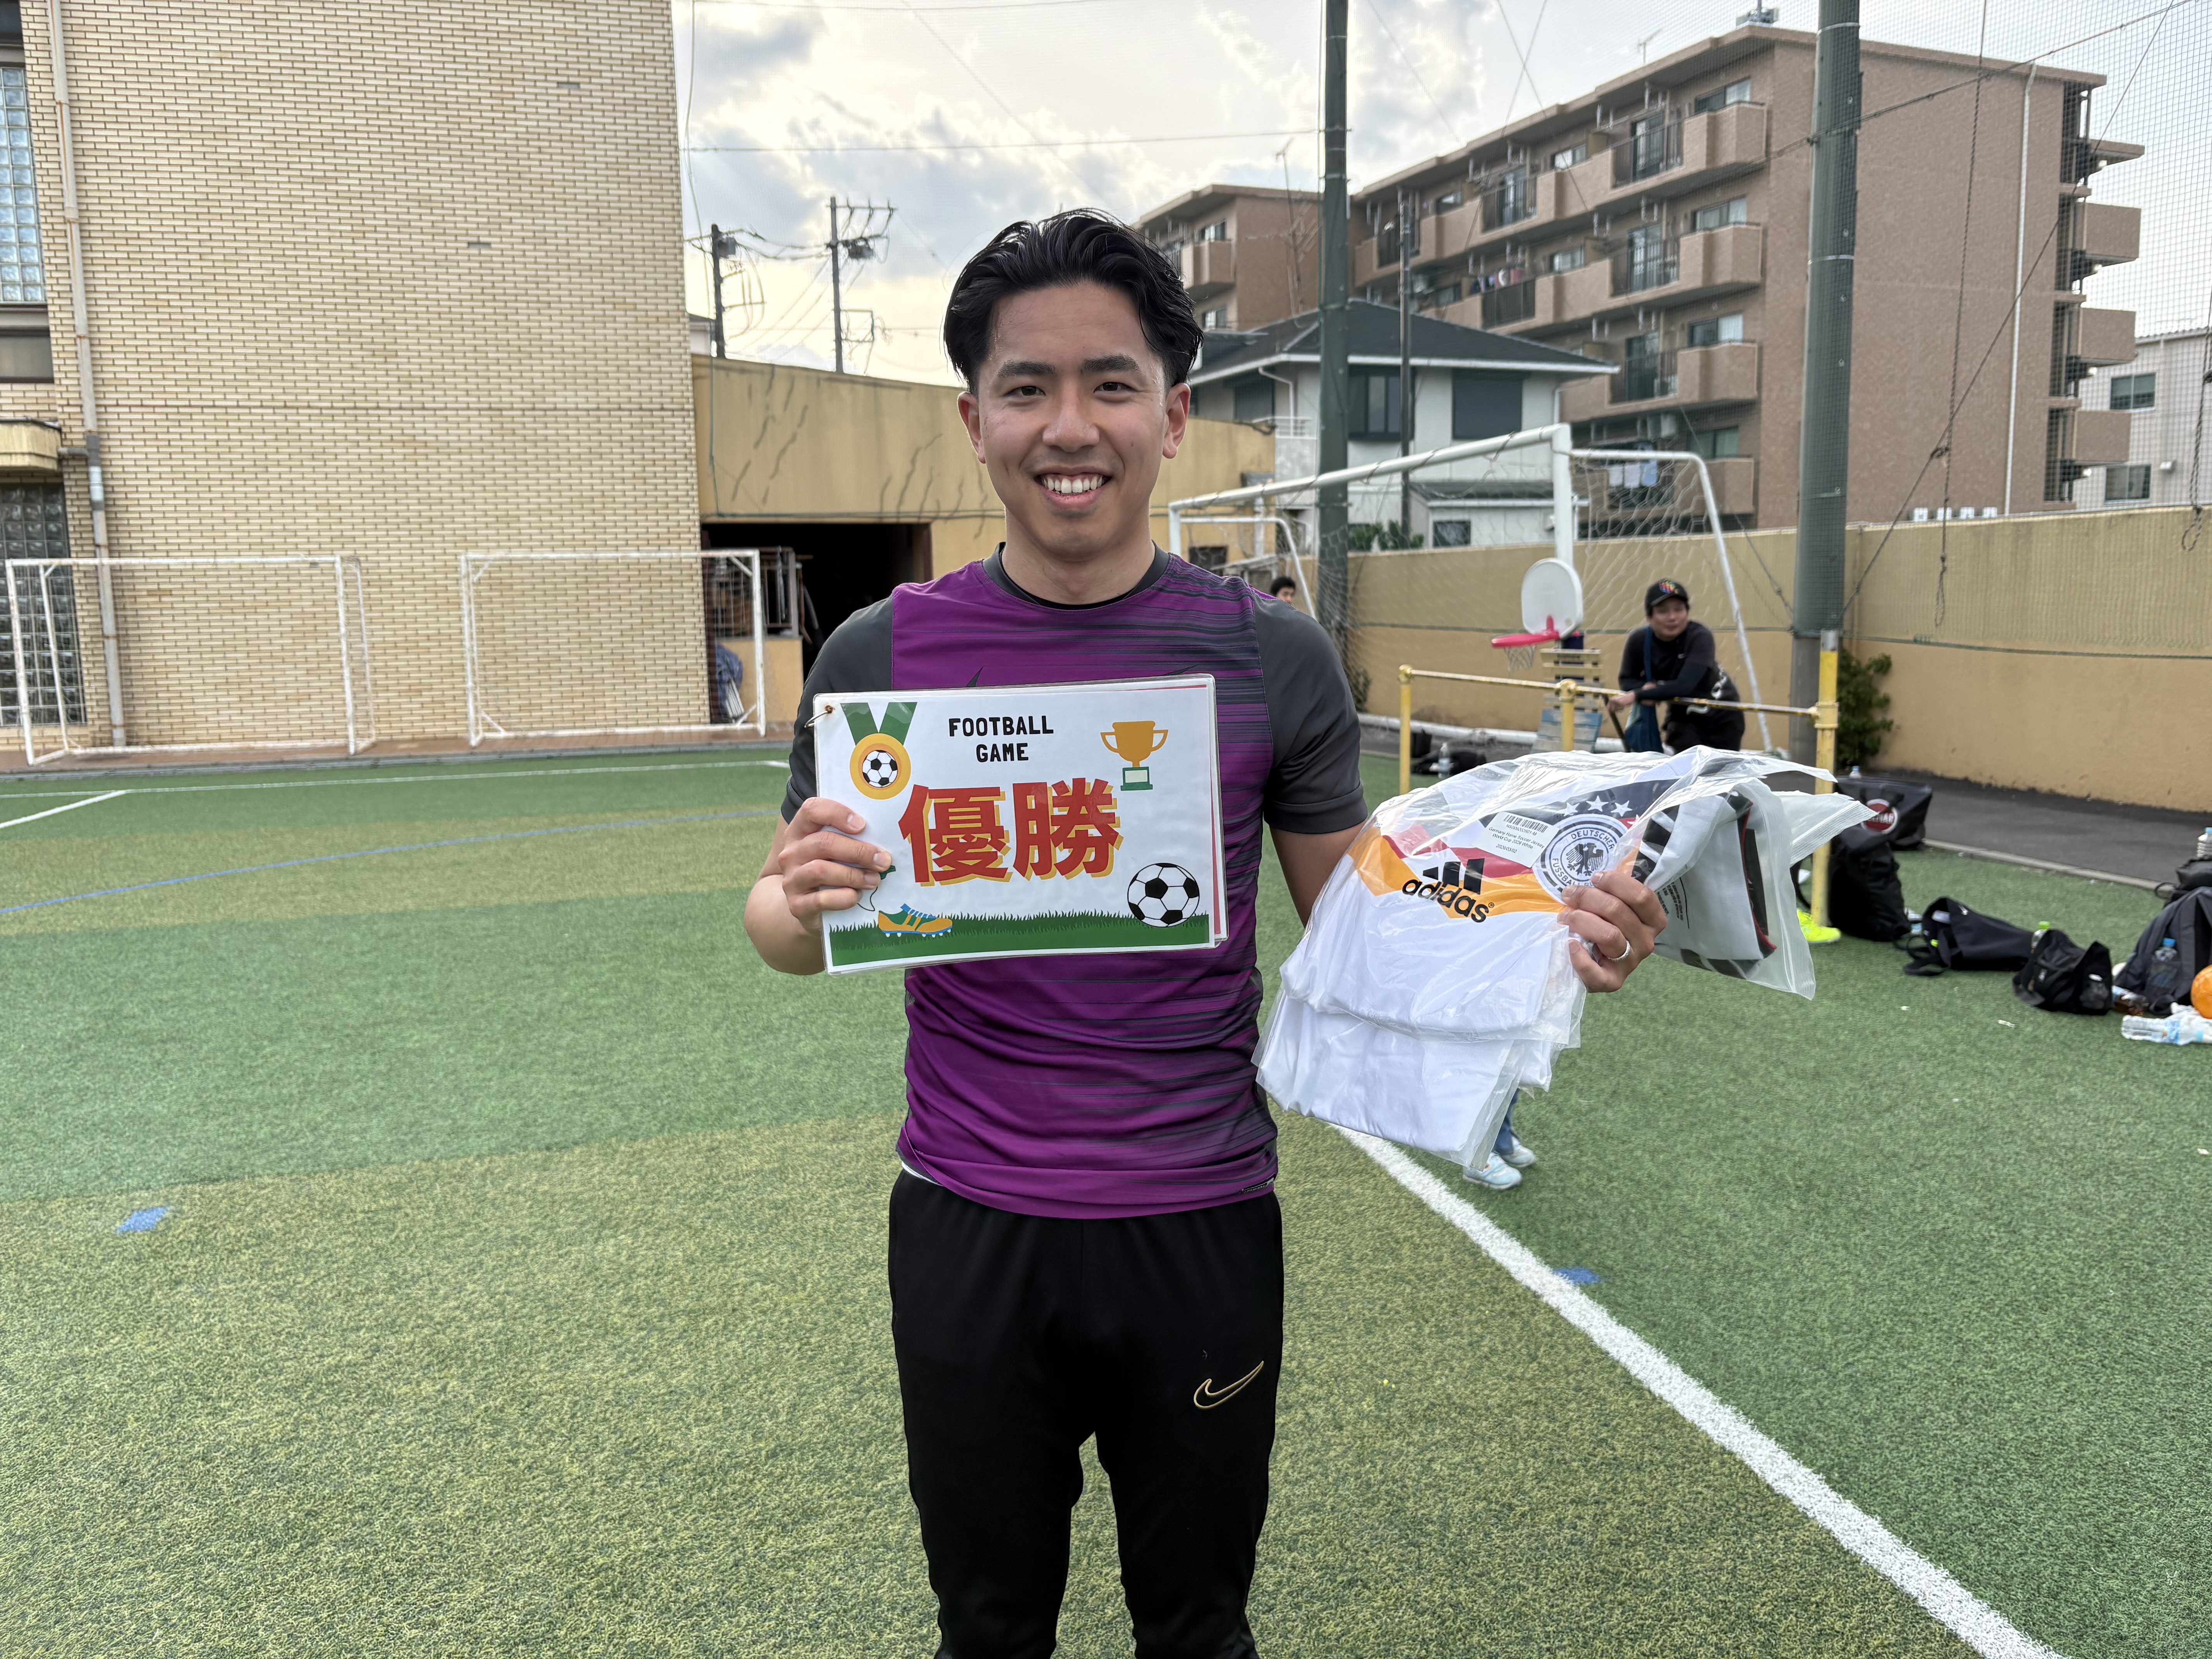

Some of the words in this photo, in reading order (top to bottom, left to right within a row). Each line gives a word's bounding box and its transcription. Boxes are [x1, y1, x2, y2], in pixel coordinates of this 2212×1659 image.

[949, 716, 1053, 736] FOOTBALL
[976, 743, 1028, 762] GAME
[898, 777, 1123, 887] 優勝
[1571, 830, 1615, 849] DEUTSCHER
[1402, 879, 1489, 923] adidas
